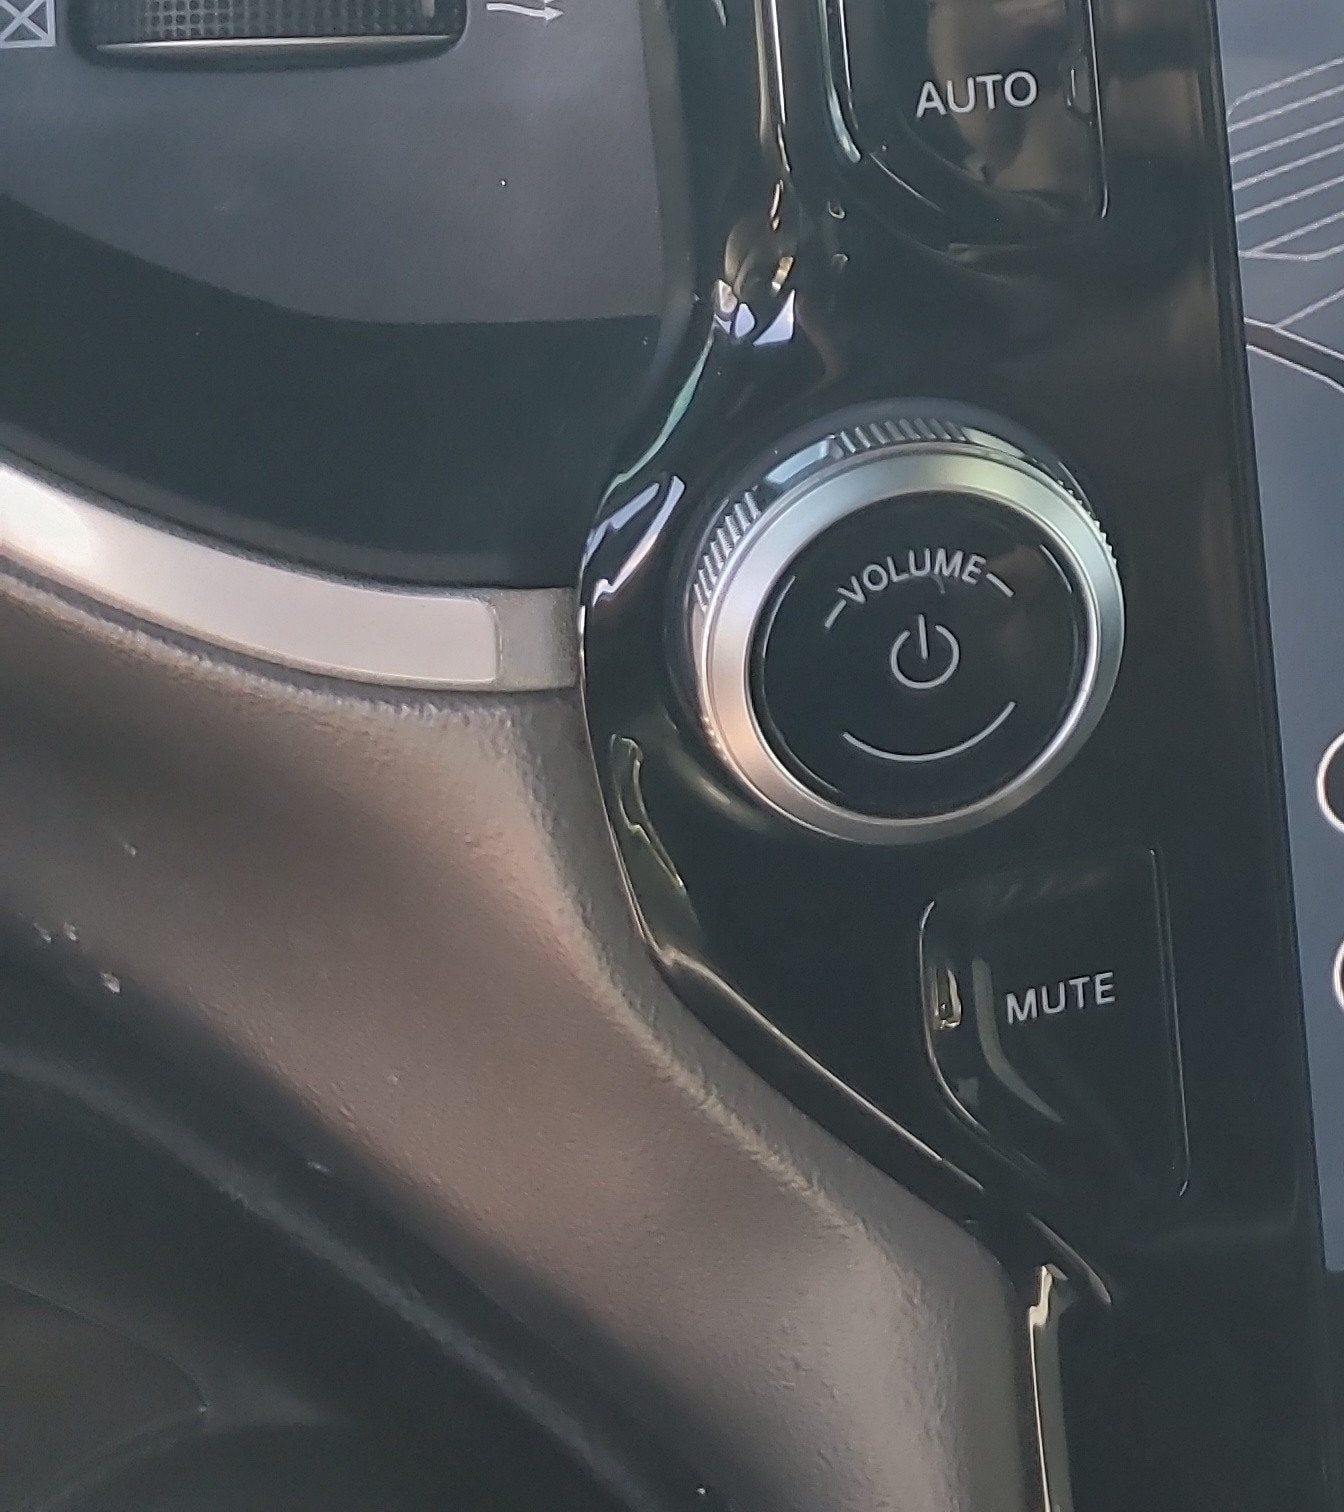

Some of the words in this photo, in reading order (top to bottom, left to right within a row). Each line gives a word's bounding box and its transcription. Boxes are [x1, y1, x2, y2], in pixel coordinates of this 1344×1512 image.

[916, 70, 1038, 119] AUTO
[837, 548, 987, 605] VOLUME
[1006, 971, 1116, 1025] MUTE
